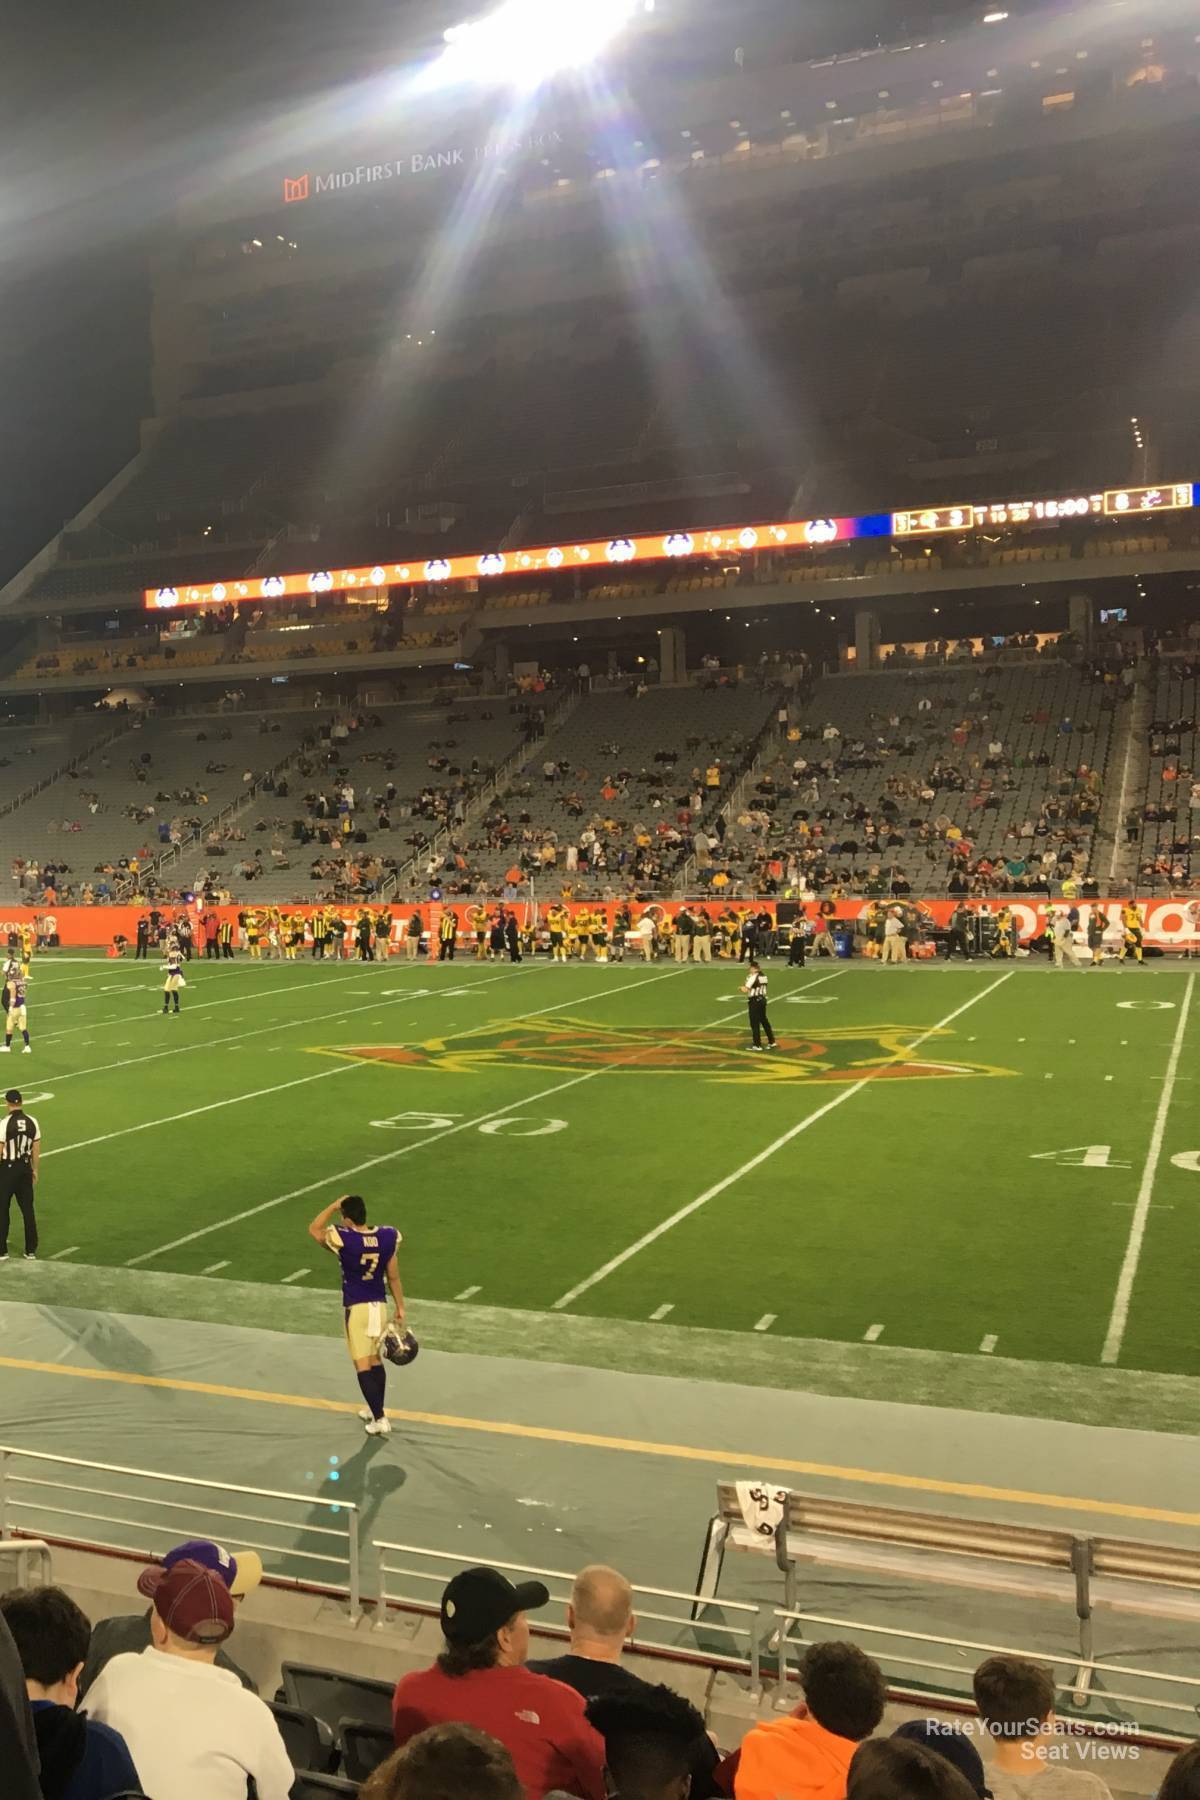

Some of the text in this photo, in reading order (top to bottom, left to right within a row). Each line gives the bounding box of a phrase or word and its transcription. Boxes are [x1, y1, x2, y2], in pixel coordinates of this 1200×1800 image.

[411, 150, 464, 173] BANK
[369, 1111, 569, 1136] 50
[360, 1253, 380, 1280] 7
